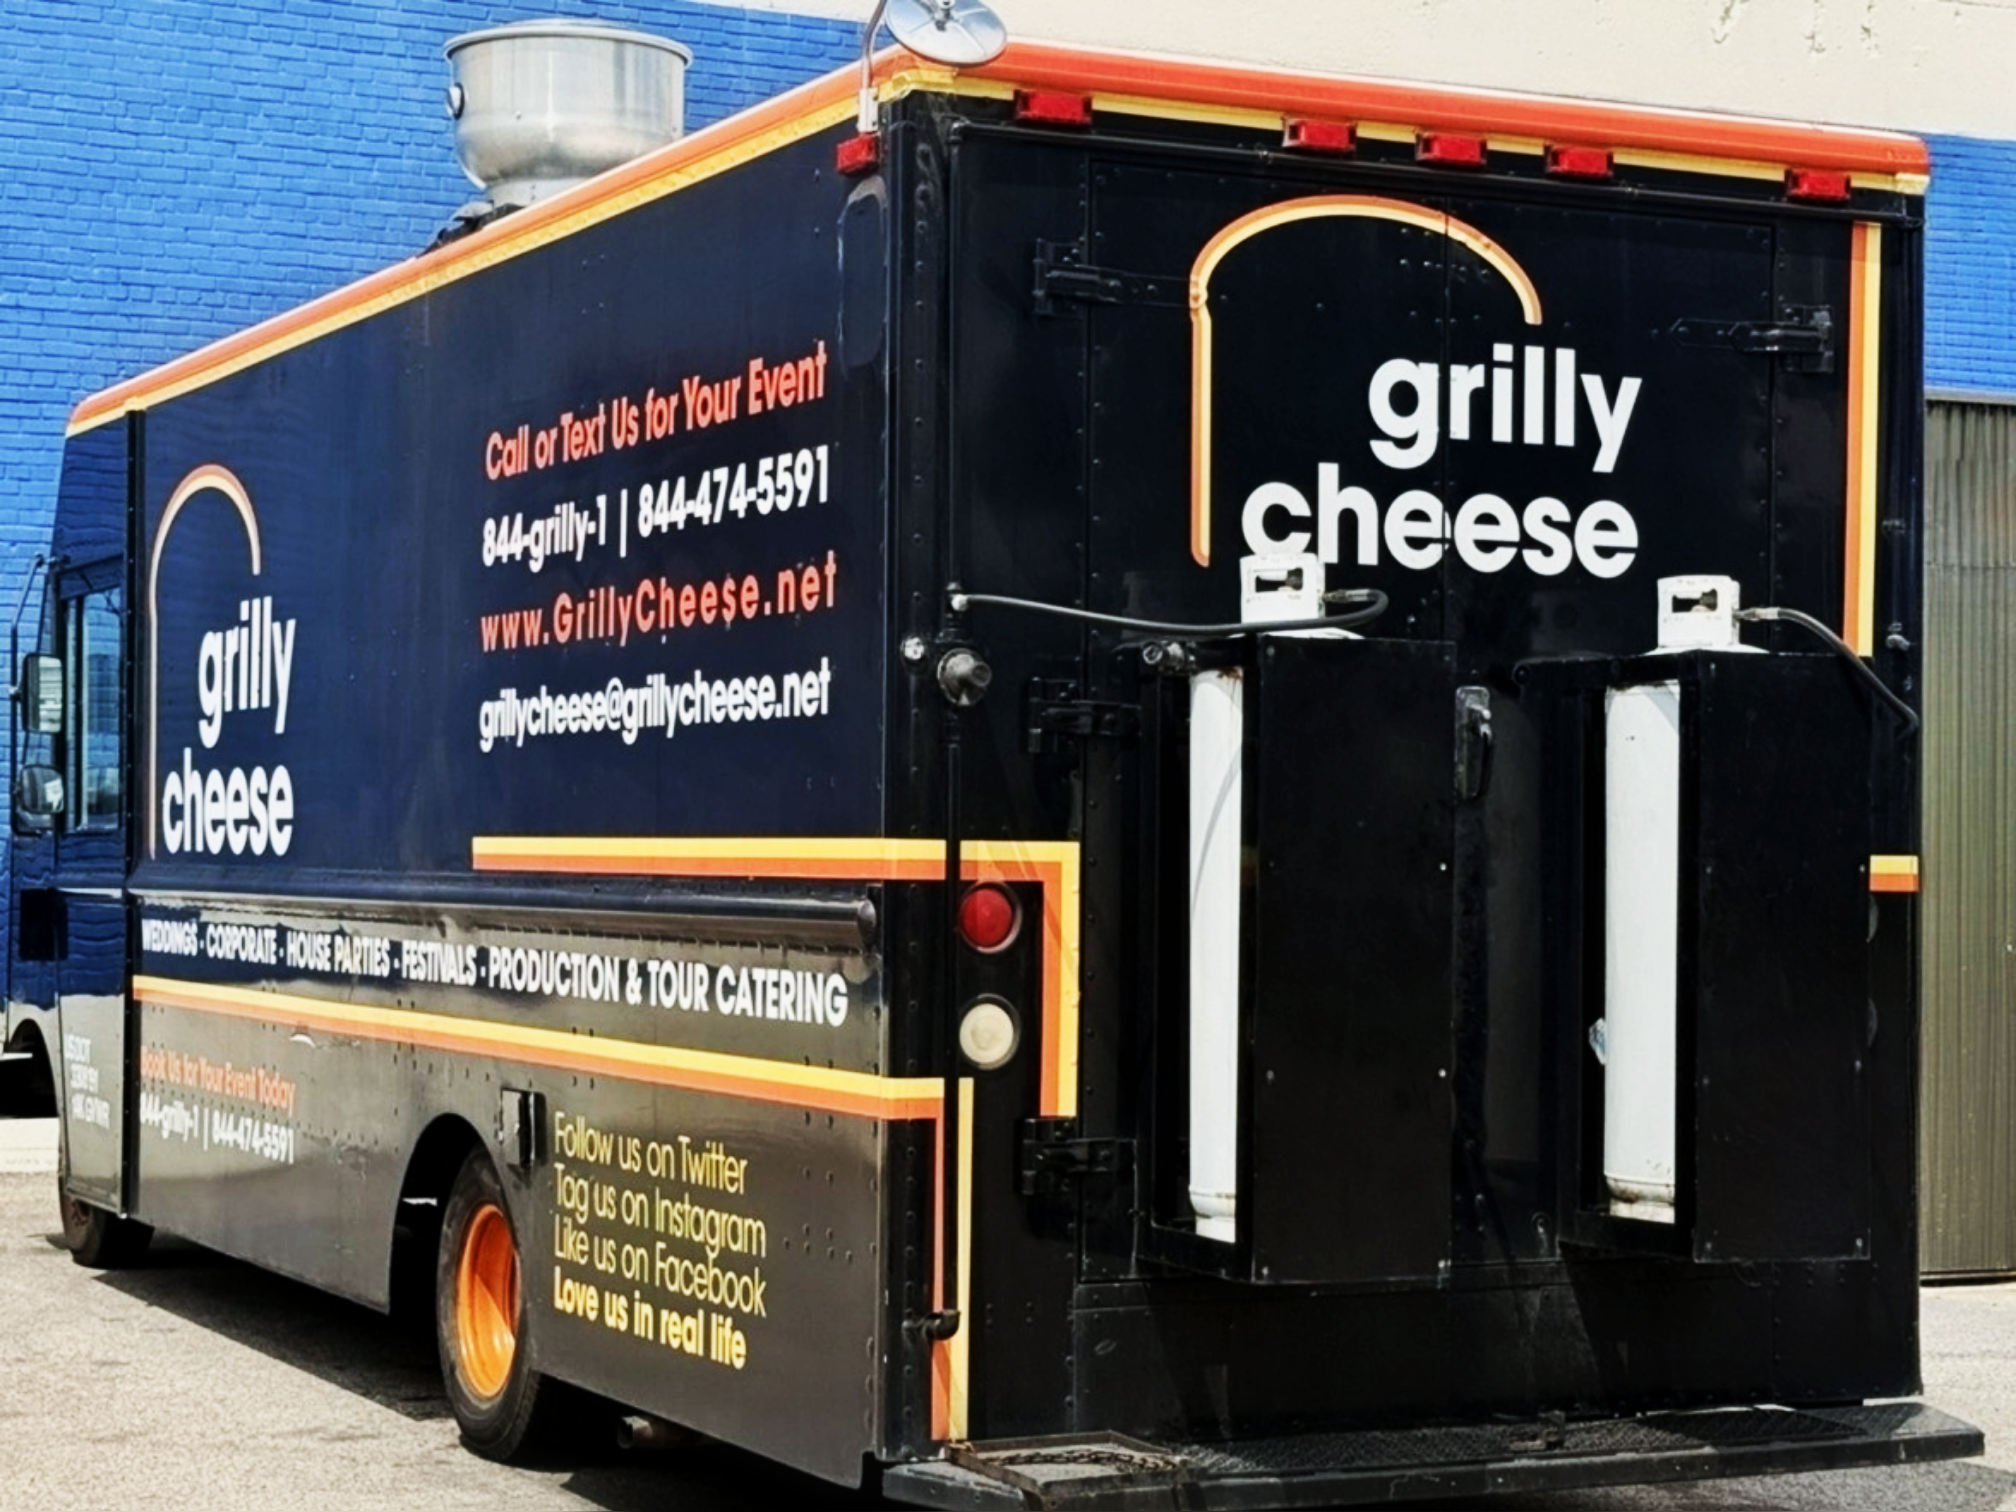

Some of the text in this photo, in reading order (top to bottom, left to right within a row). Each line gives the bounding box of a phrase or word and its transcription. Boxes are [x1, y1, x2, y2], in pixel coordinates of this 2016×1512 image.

[486, 340, 827, 480] Call or Text Us for Your Event
[1368, 343, 1642, 473] grilly
[482, 495, 607, 573] 844-grilly-1
[639, 445, 829, 538] 844-474-5591
[1241, 462, 1639, 579] cheese
[480, 549, 837, 652] www.GrillyCheese.net
[198, 596, 296, 748] grilly
[479, 656, 831, 753] grillycheese@grillycheese.net
[162, 747, 294, 856] cheese
[141, 917, 198, 957] WEDDINGS
[206, 924, 277, 965] CORPORATE
[286, 931, 331, 972] HOUSE
[334, 935, 390, 977] PARTIES
[402, 939, 477, 986] FESTIVALS
[489, 946, 620, 1002] PRODUCTION
[626, 959, 642, 1005] &
[647, 959, 709, 1012] TOUR
[715, 966, 848, 1027] CATERING
[212, 1109, 294, 1164] 844-474-5591
[257, 1067, 296, 1117] Today
[554, 1111, 747, 1195] Follow us on Twitter
[553, 1162, 767, 1258] Tag us on Instagram
[553, 1216, 767, 1318] Like us on Facebook
[553, 1266, 747, 1369] Love us in real life
